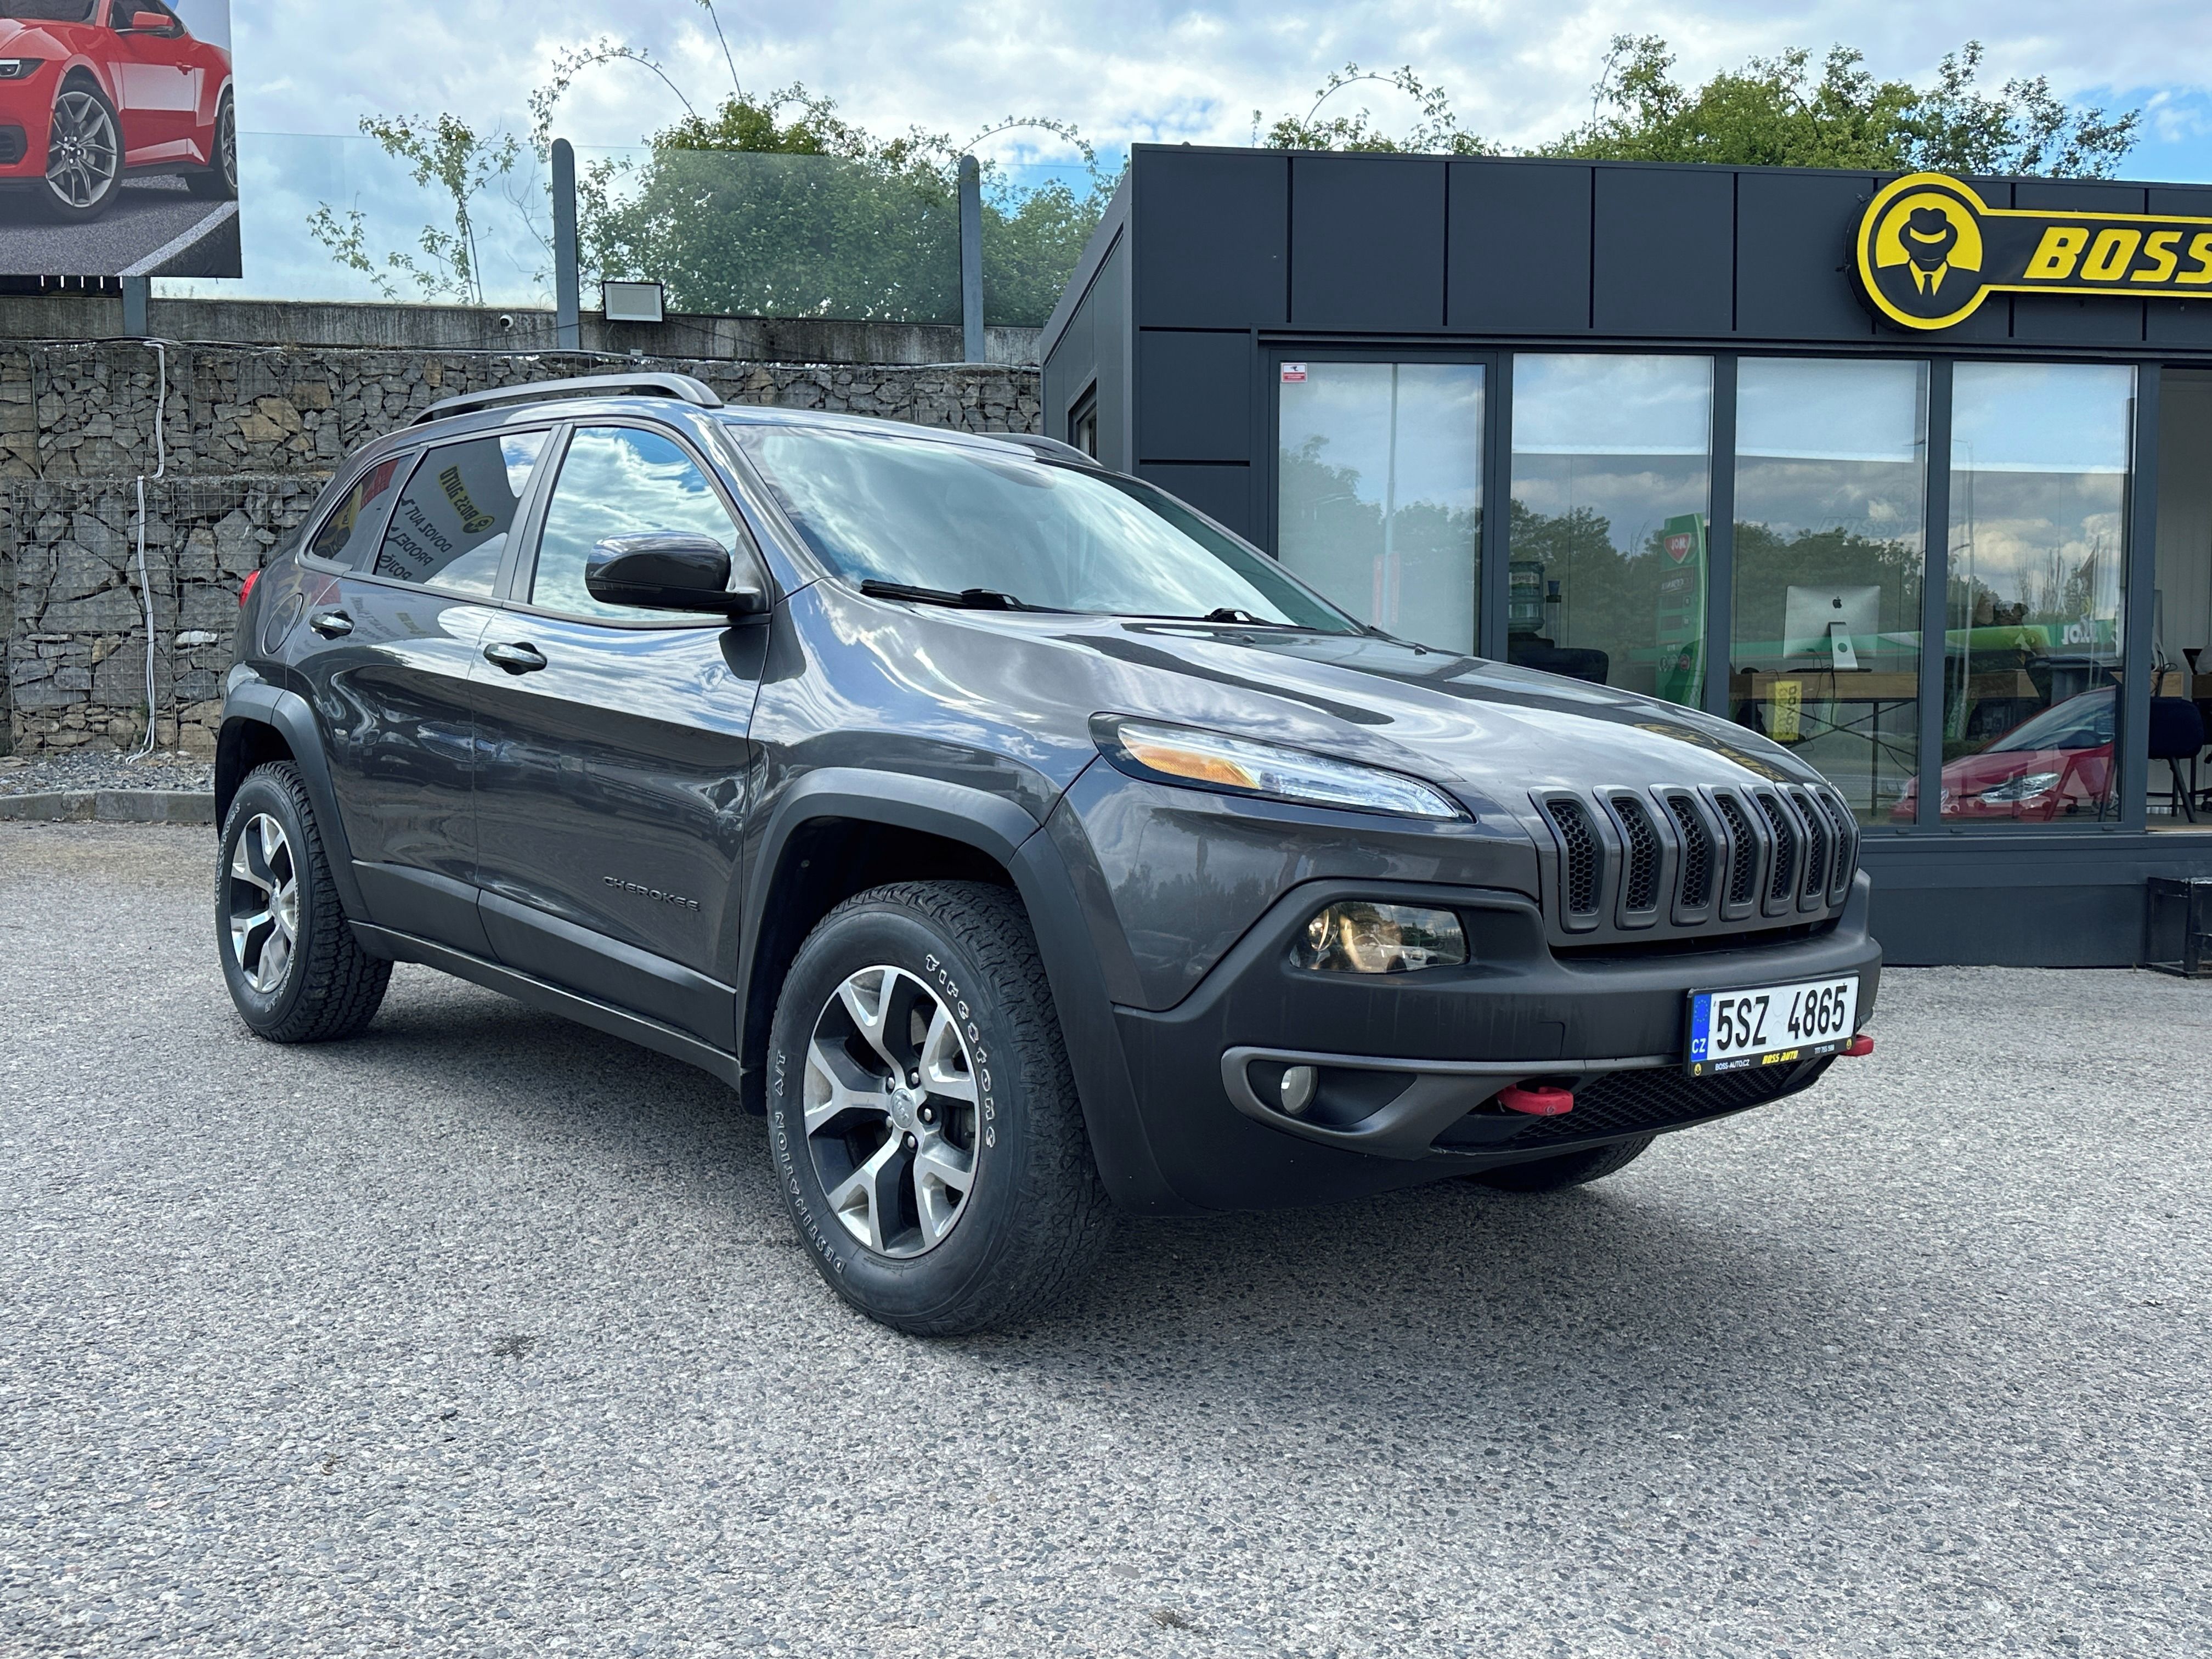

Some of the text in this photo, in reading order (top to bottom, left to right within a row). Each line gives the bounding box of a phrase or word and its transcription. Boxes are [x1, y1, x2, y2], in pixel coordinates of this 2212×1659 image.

[2023, 226, 2212, 284] BOSS
[603, 876, 699, 912] CHEROKEE
[1692, 1038, 1706, 1054] CZ
[1717, 985, 1848, 1051] 5SZ 4865
[775, 1049, 847, 1274] DESTINATION A/T
